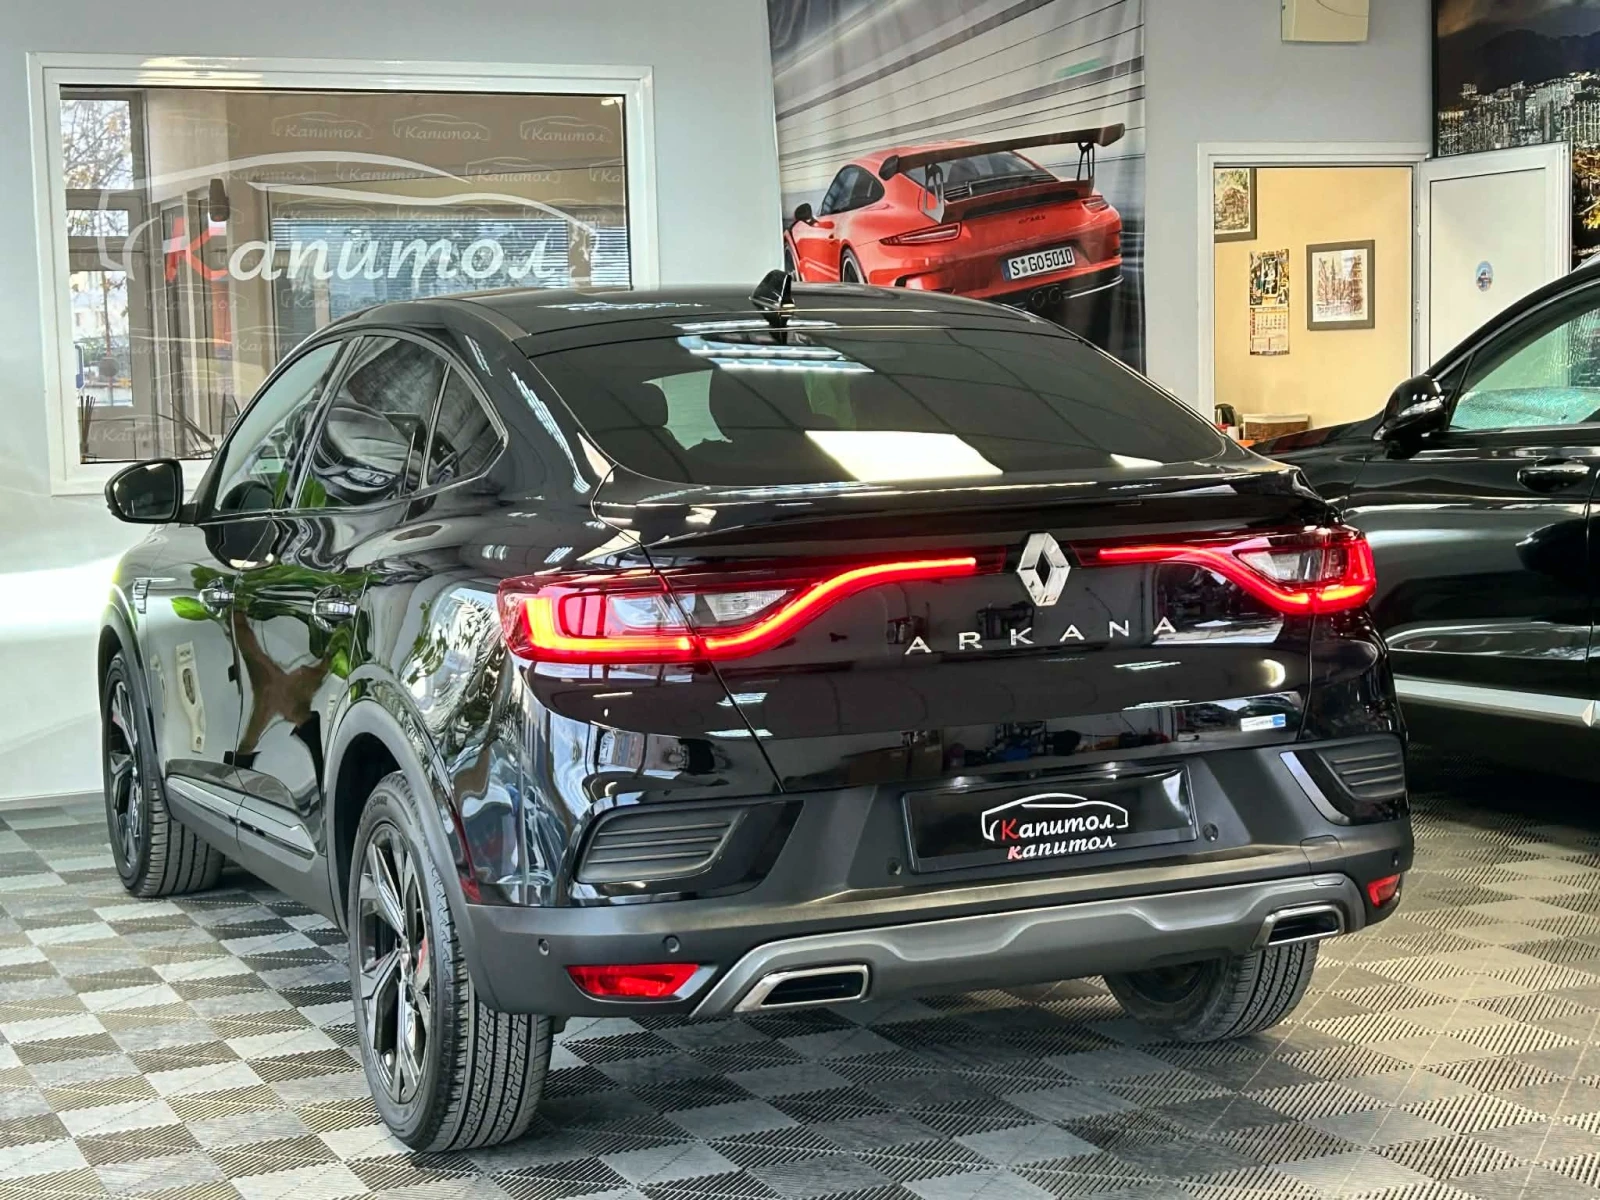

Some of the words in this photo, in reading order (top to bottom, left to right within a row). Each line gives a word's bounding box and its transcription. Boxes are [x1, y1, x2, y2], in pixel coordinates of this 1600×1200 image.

[405, 125, 482, 140] Капитол
[532, 127, 604, 142] Капитол
[163, 216, 557, 282] Капитол
[1011, 260, 1020, 276] S
[904, 616, 1176, 655] ARKANA
[1002, 814, 1114, 841] Капитол
